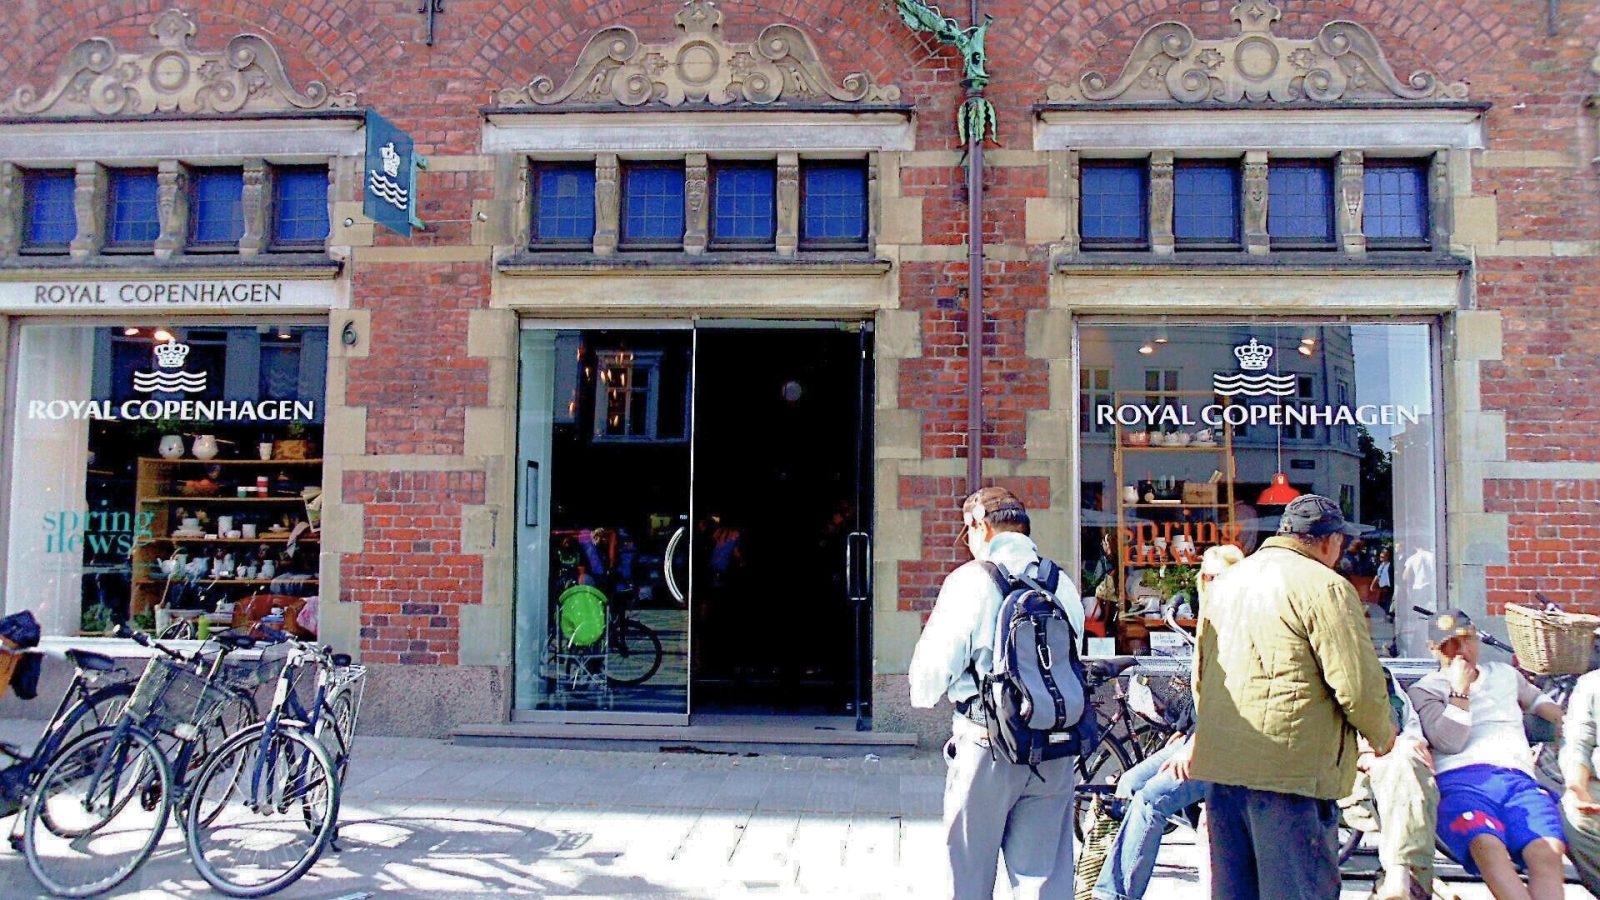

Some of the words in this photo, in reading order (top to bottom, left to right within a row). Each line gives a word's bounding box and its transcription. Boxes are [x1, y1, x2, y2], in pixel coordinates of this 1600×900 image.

[35, 284, 105, 303] ROYAL
[119, 283, 281, 303] COPENHAGEN
[28, 400, 118, 420] ROYAL
[121, 400, 314, 420] COPENHAGEN
[1096, 404, 1195, 426] ROYAL
[1201, 404, 1420, 426] COPENHAGEN
[43, 500, 154, 553] spring
[1118, 508, 1244, 564] spring
[1122, 545, 1204, 566] new
